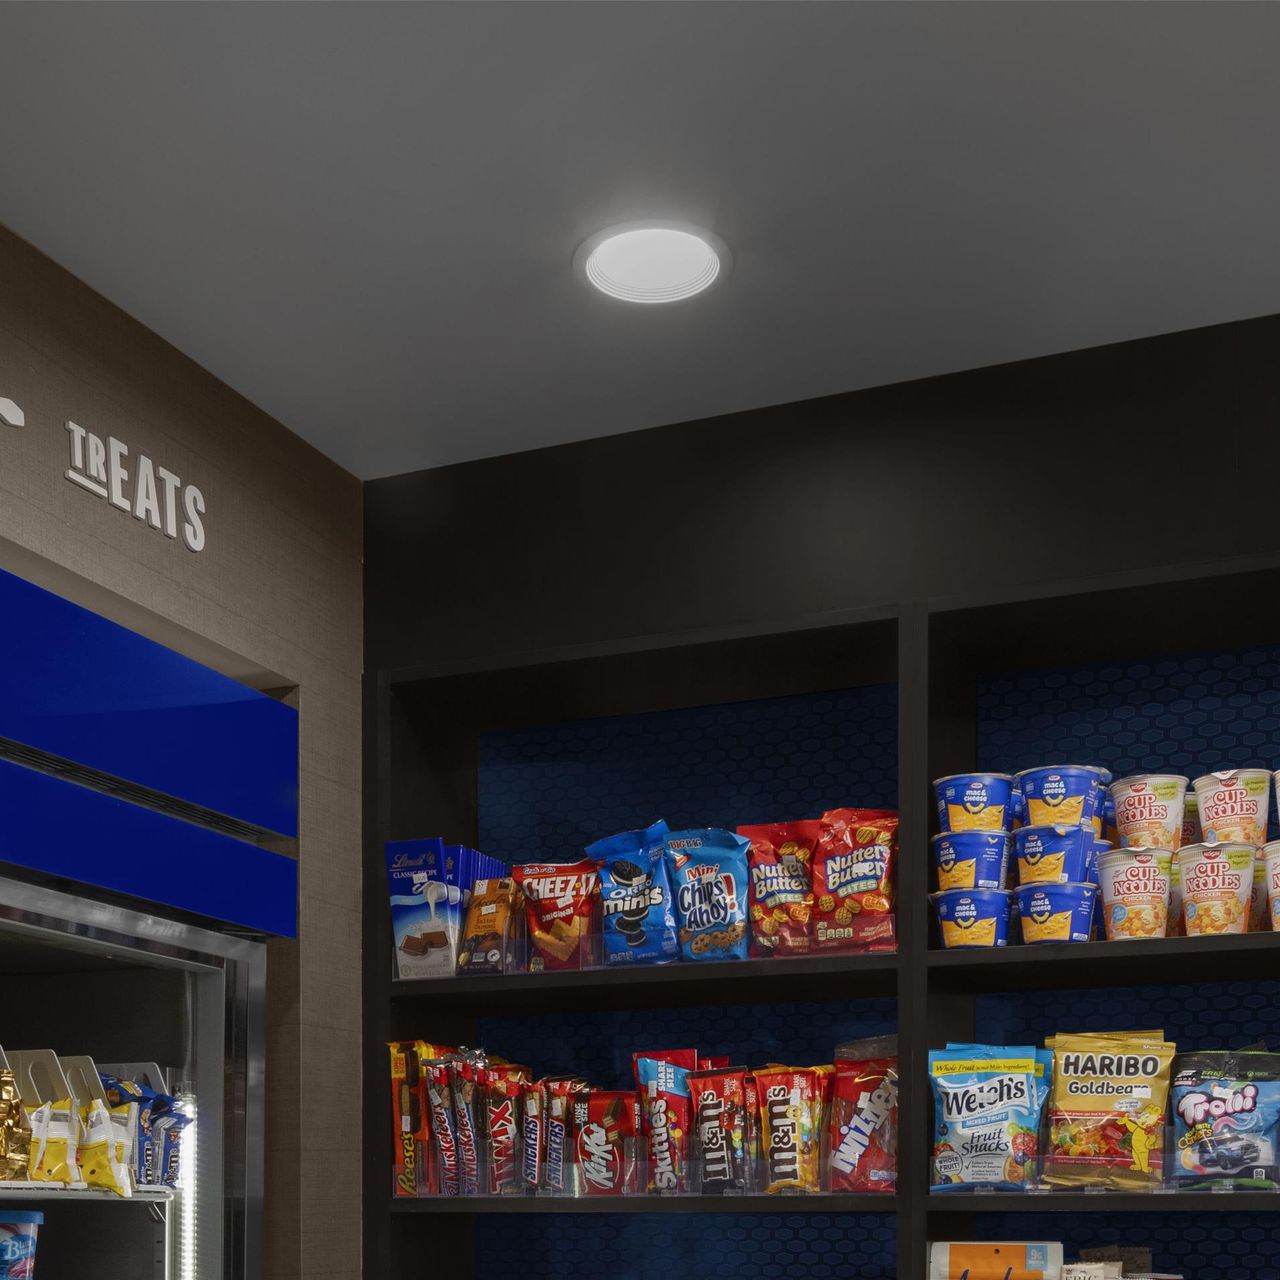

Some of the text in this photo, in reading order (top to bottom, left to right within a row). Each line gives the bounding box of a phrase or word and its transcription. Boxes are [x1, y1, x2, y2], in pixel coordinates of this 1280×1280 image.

[65, 420, 206, 552] TREATS
[1126, 867, 1160, 881] CUP
[1195, 863, 1230, 877] CUP
[658, 1061, 666, 1091] SHARE
[1062, 1055, 1159, 1077] HARIBO
[666, 1067, 674, 1088] SIZE
[970, 1130, 1004, 1143] Fruit
[523, 1117, 539, 1183] SNICKERS
